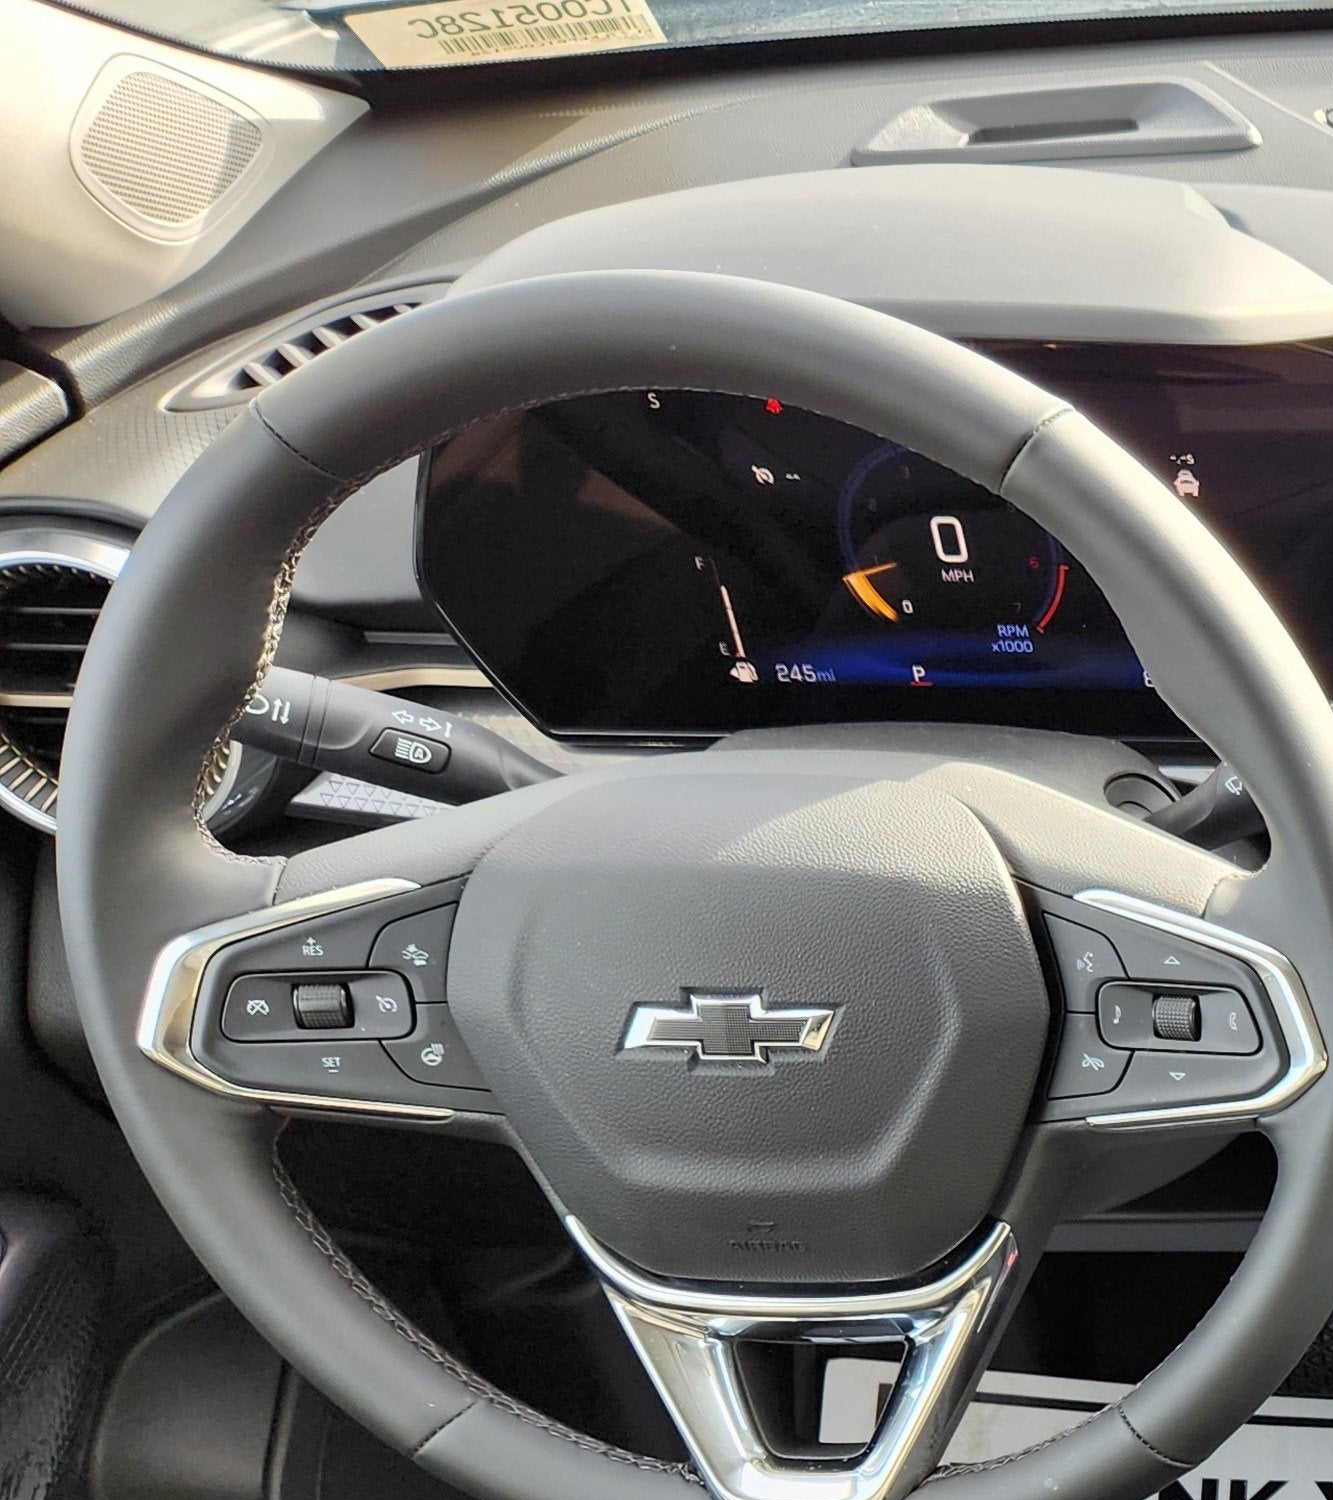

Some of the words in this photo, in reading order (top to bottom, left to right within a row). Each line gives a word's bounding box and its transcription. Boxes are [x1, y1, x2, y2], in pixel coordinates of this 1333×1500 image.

[930, 515, 969, 563] 0
[941, 568, 976, 583] MPH
[996, 623, 1030, 637] RPM
[991, 638, 1034, 653] x1000
[911, 663, 926, 683] P
[302, 944, 324, 957] RES
[321, 1055, 342, 1068] SET
